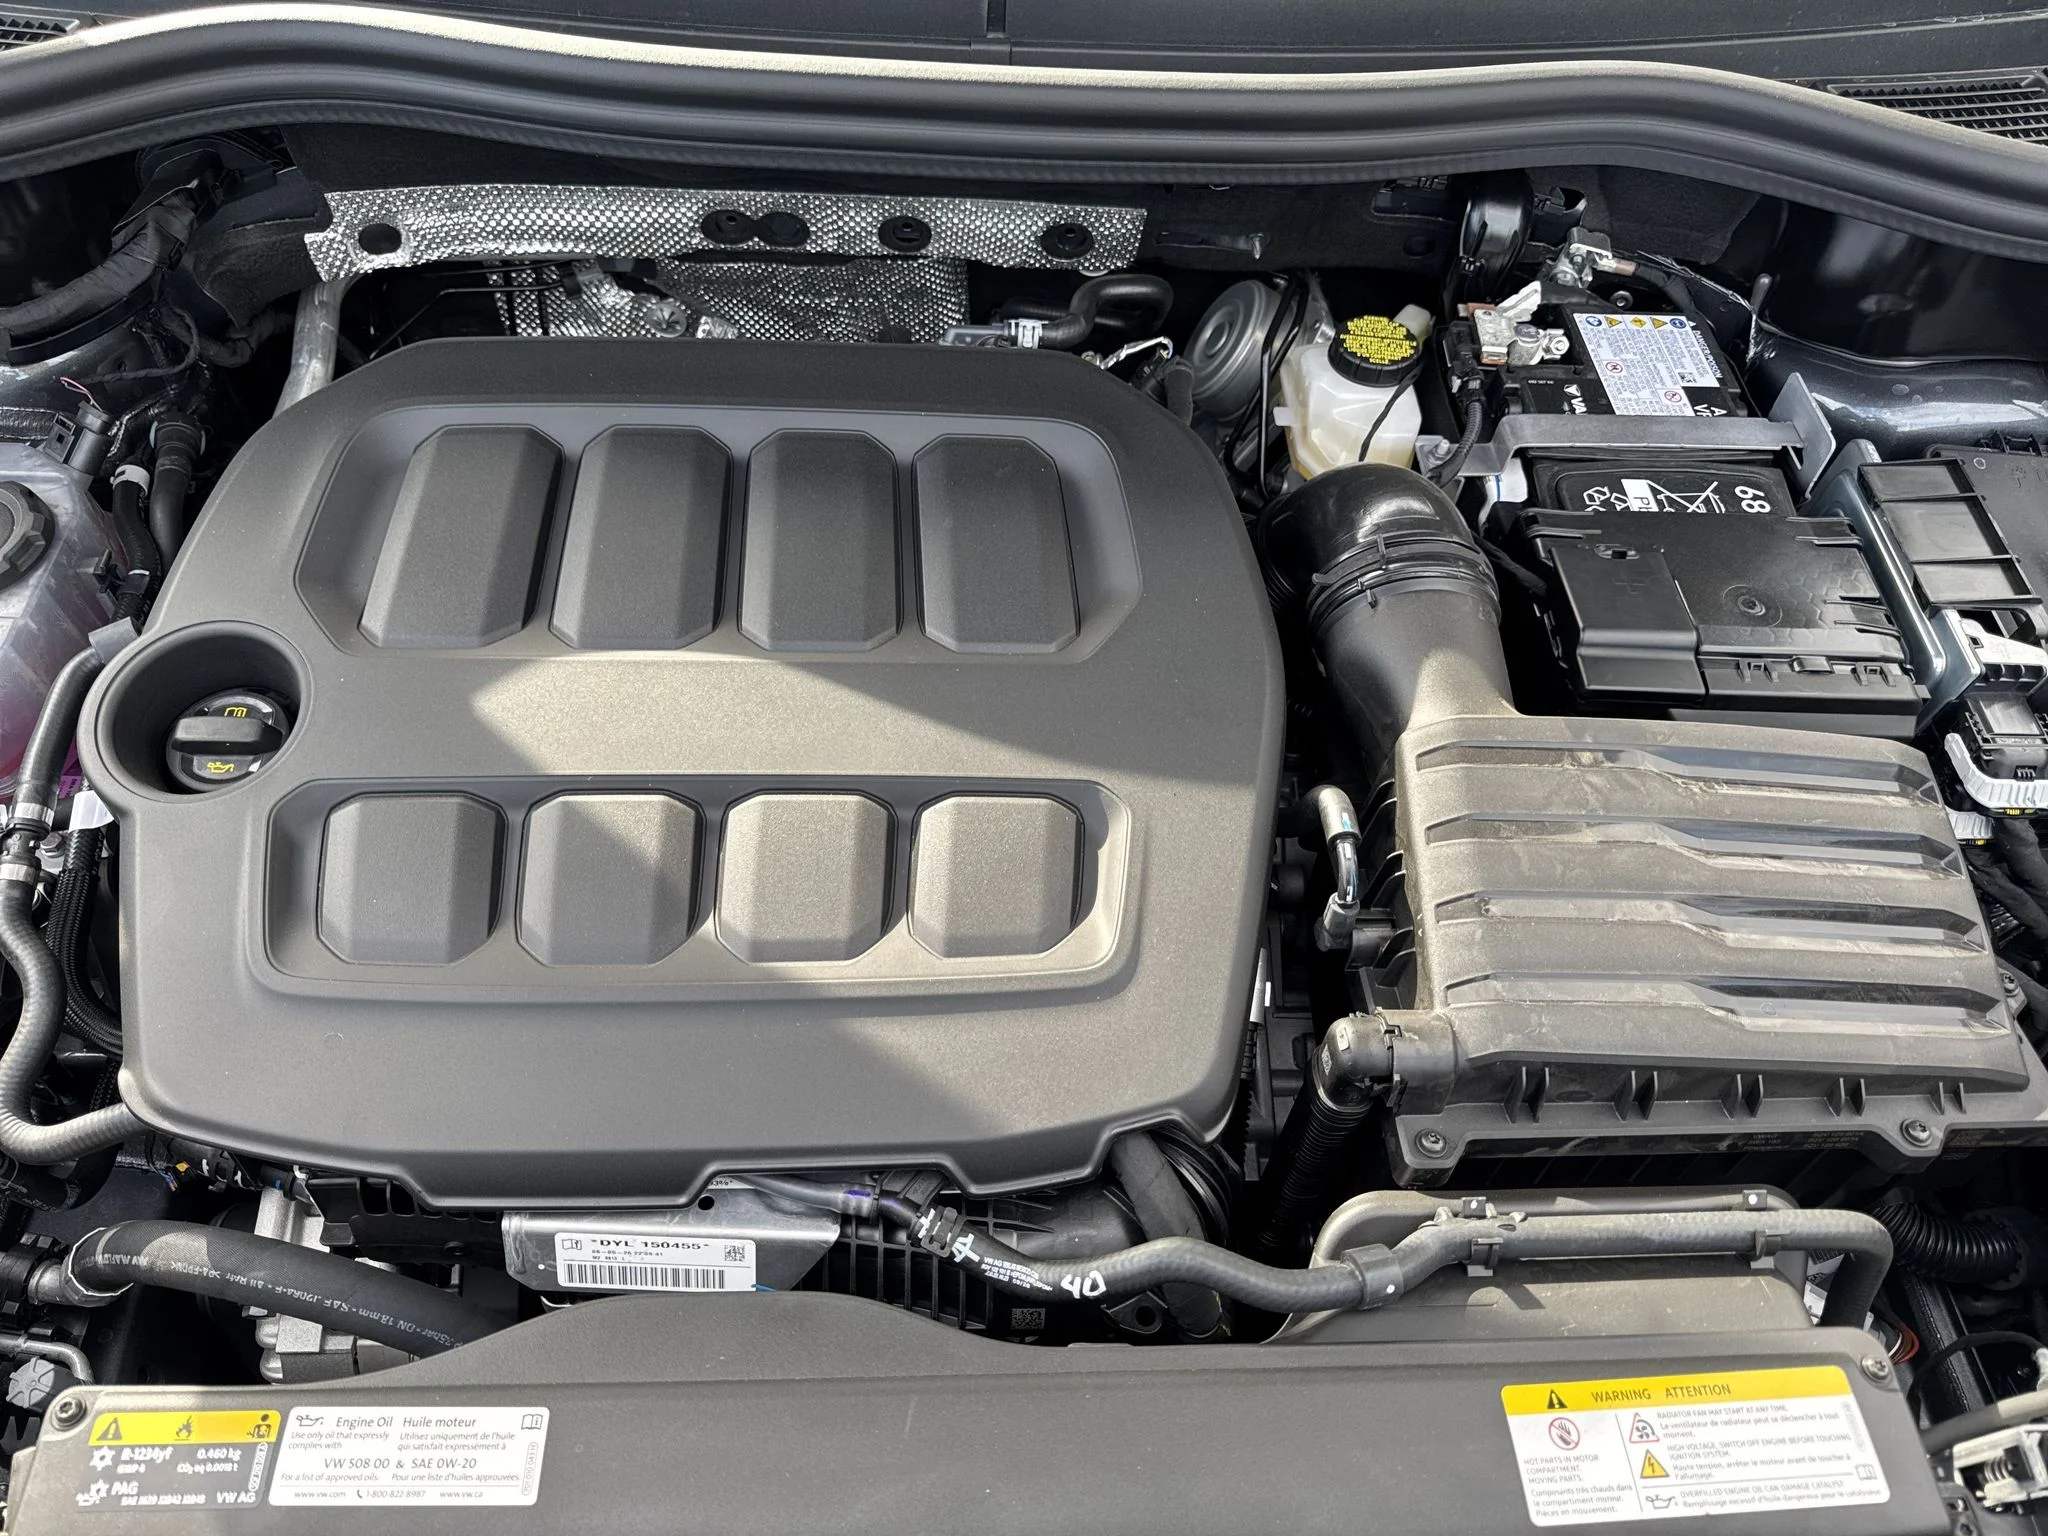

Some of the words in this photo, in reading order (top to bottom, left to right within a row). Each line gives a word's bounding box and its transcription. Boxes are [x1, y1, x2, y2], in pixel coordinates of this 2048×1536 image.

[1570, 397, 1588, 415] VA
[1060, 1270, 1107, 1299] 40
[1591, 1388, 1651, 1402] WARNING
[1665, 1384, 1731, 1399] ATTENTION
[1657, 1411, 1691, 1419] RADIATOR
[1693, 1409, 1707, 1417] FAN
[1708, 1408, 1722, 1416] MAY
[1723, 1407, 1743, 1415] START
[336, 1417, 374, 1430] Engine
[377, 1416, 393, 1427] Oil
[403, 1417, 432, 1427] Huile
[435, 1418, 477, 1427] moteur
[1670, 1421, 1708, 1429] ventilateur
[1720, 1418, 1751, 1426] radiateur
[1753, 1417, 1769, 1425] peut
[307, 1432, 324, 1440] only
[353, 1432, 390, 1441] expressly
[400, 1432, 429, 1440] Utilisez
[430, 1432, 478, 1442] uniquement
[480, 1432, 490, 1440] de
[491, 1432, 515, 1440] l'huile
[1667, 1443, 1684, 1451] HIGH
[1719, 1440, 1745, 1448] SWITCH
[1761, 1438, 1787, 1446] ENGINE
[1790, 1436, 1815, 1444] BEFORE
[1816, 1433, 1851, 1442] TOUCHING
[288, 1442, 322, 1450] complies
[397, 1443, 410, 1452] qui
[412, 1442, 443, 1450] satisfait
[121, 1446, 174, 1463] R-1234yf
[197, 1447, 226, 1460] 0.460
[229, 1447, 242, 1461] kg
[1541, 1456, 1563, 1464] PARTS
[1573, 1454, 1599, 1462] MOTOR
[324, 1458, 346, 1469] VW
[349, 1458, 370, 1469] 508
[373, 1458, 390, 1469] 00
[395, 1460, 405, 1469] &
[411, 1458, 434, 1469] SAE
[436, 1458, 477, 1469] 0W-20
[1760, 1458, 1785, 1466] moteur
[281, 1473, 295, 1481] For
[302, 1473, 314, 1481] list
[315, 1473, 324, 1481] of
[325, 1473, 363, 1483] approved
[391, 1473, 410, 1481] Pour
[427, 1473, 443, 1481] liste
[445, 1473, 474, 1481] d'huiles
[1529, 1476, 1558, 1484] MOVING
[110, 1481, 140, 1495] PAG
[1531, 1487, 1575, 1498] Composants
[1576, 1486, 1589, 1494] très
[1590, 1484, 1615, 1493] chauds
[1680, 1488, 1723, 1498] OVERFILLED
[1724, 1487, 1750, 1495] ENGINE
[1764, 1485, 1780, 1493] CAN
[216, 1491, 238, 1504] VW
[238, 1491, 256, 1504] AG
[1542, 1497, 1594, 1507] compartiment
